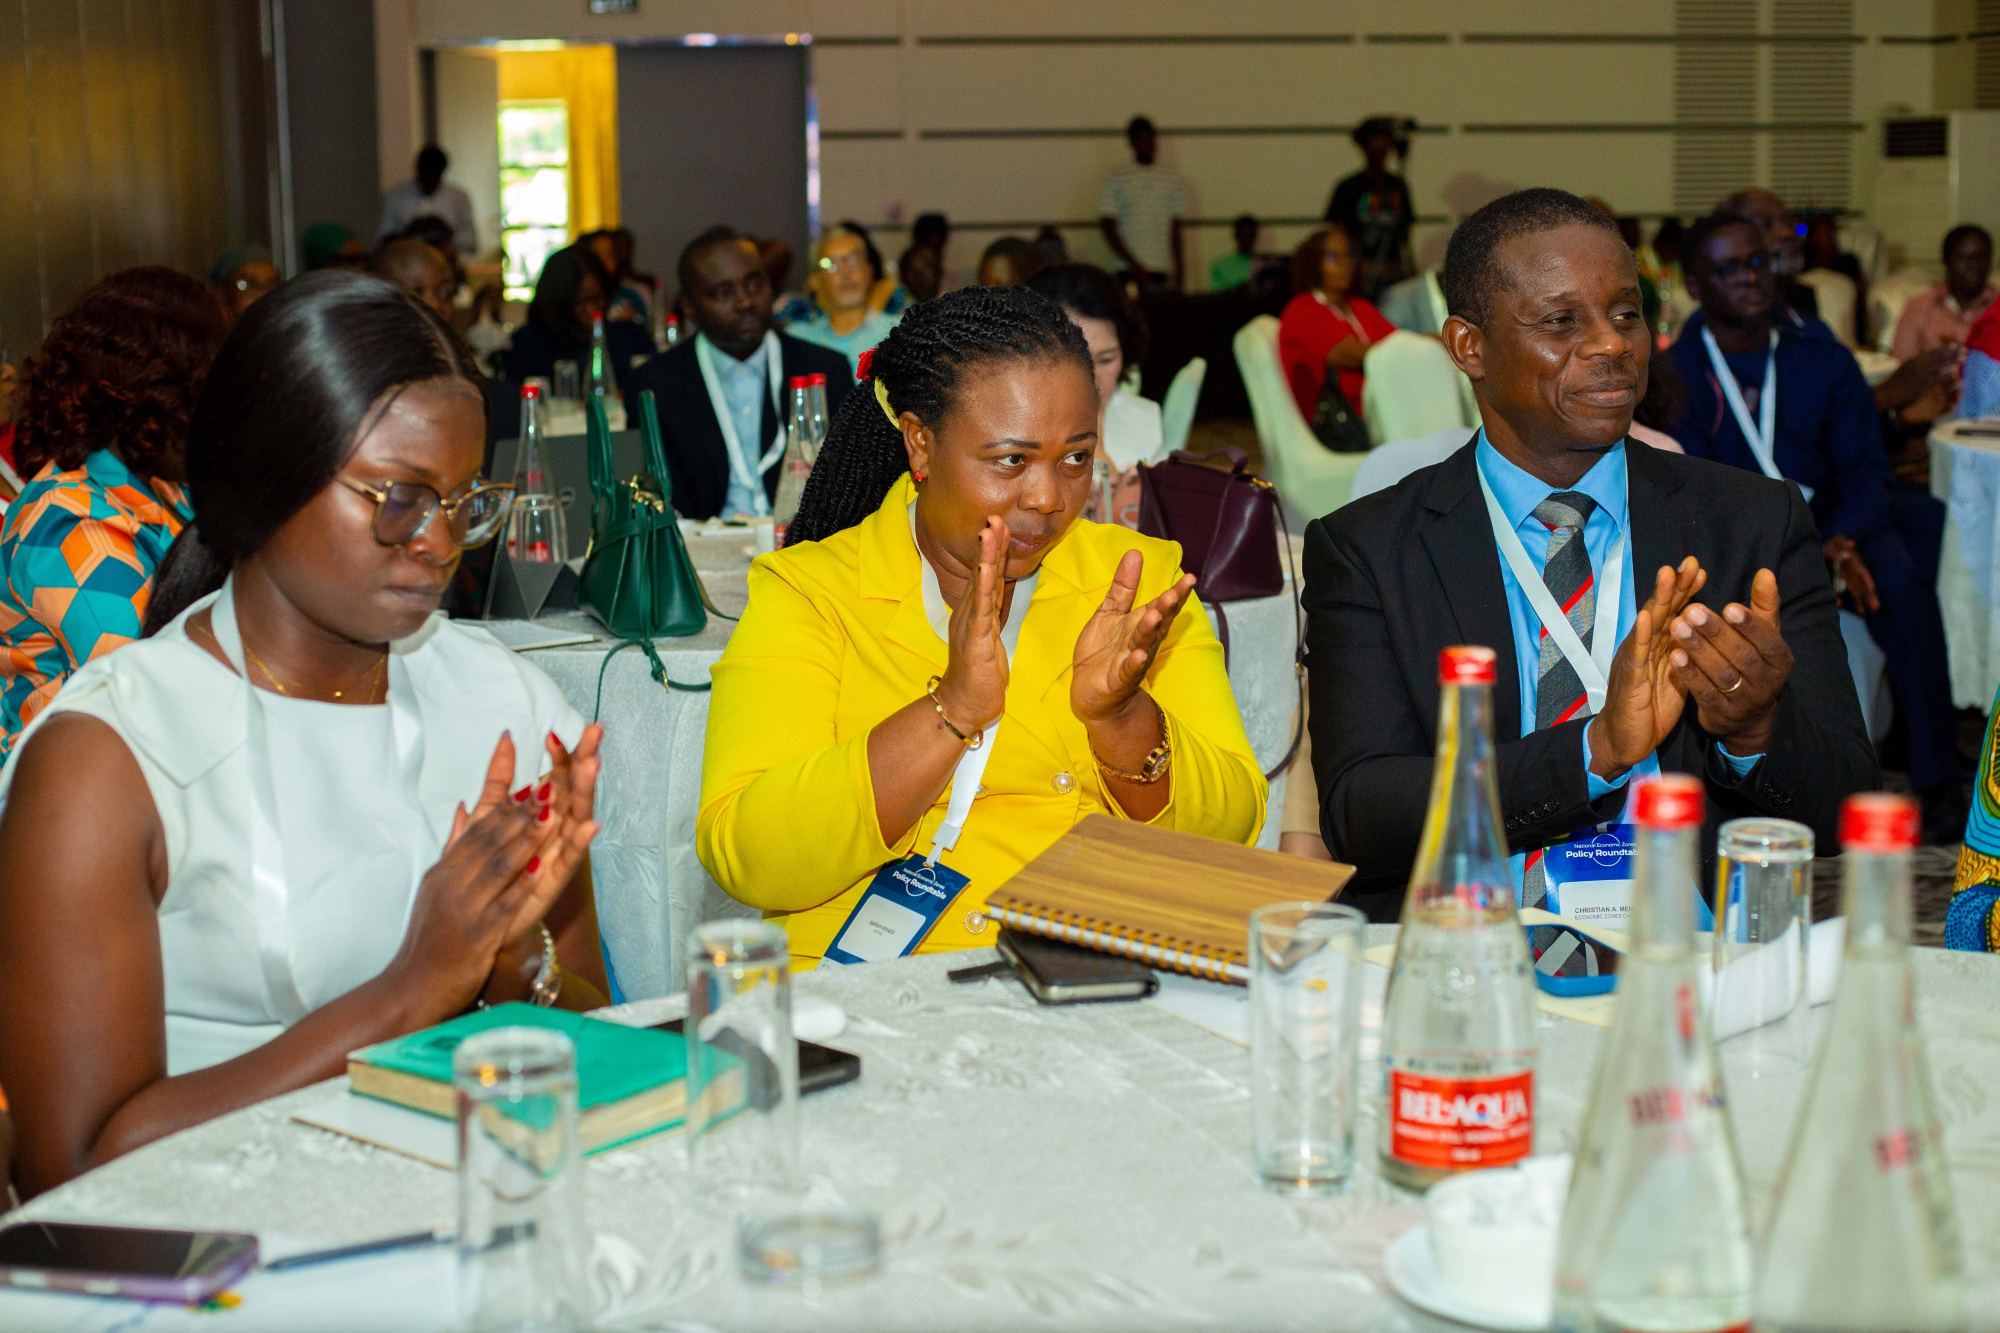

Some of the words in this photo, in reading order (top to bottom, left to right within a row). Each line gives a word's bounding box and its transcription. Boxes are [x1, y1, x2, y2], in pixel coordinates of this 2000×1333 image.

[1566, 850, 1594, 858] Policy
[1595, 848, 1639, 857] Roundtab
[892, 870, 911, 884] Policy
[910, 878, 947, 900] Roundtable
